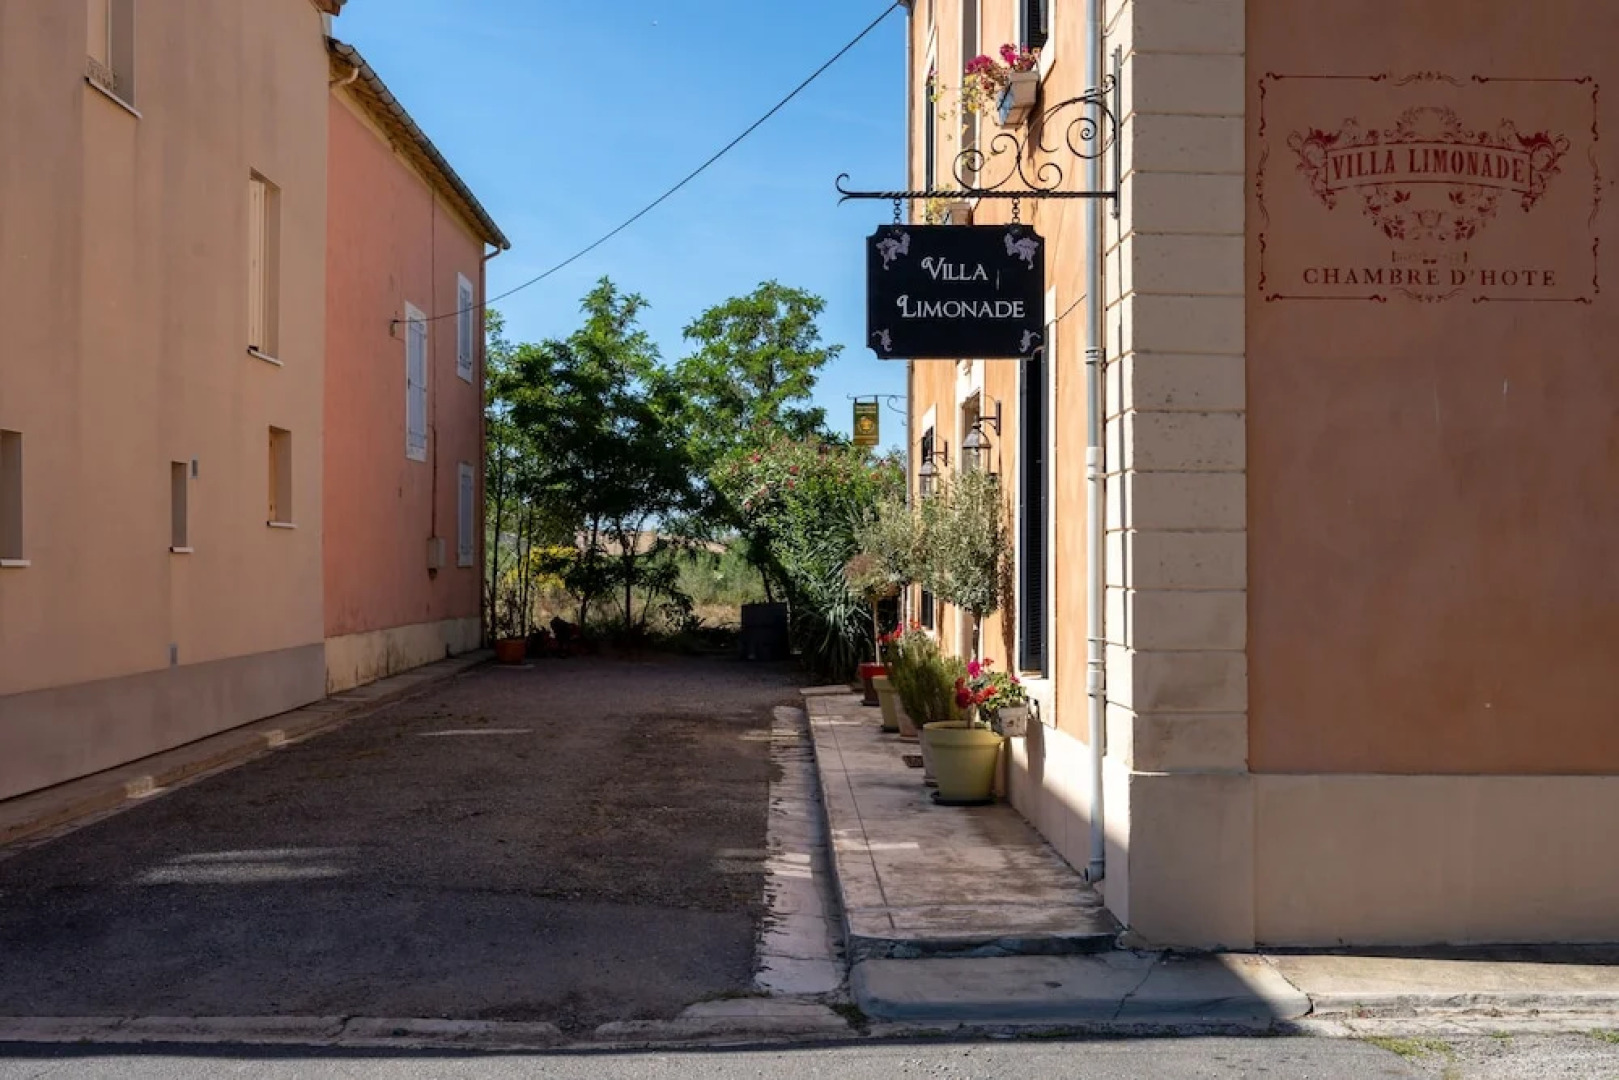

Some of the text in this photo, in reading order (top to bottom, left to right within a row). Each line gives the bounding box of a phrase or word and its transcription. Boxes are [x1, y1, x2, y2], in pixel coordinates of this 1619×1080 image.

[1332, 148, 1525, 183] VILLA LIMONADE
[1303, 268, 1557, 287] CHAMBRE D'HOTE
